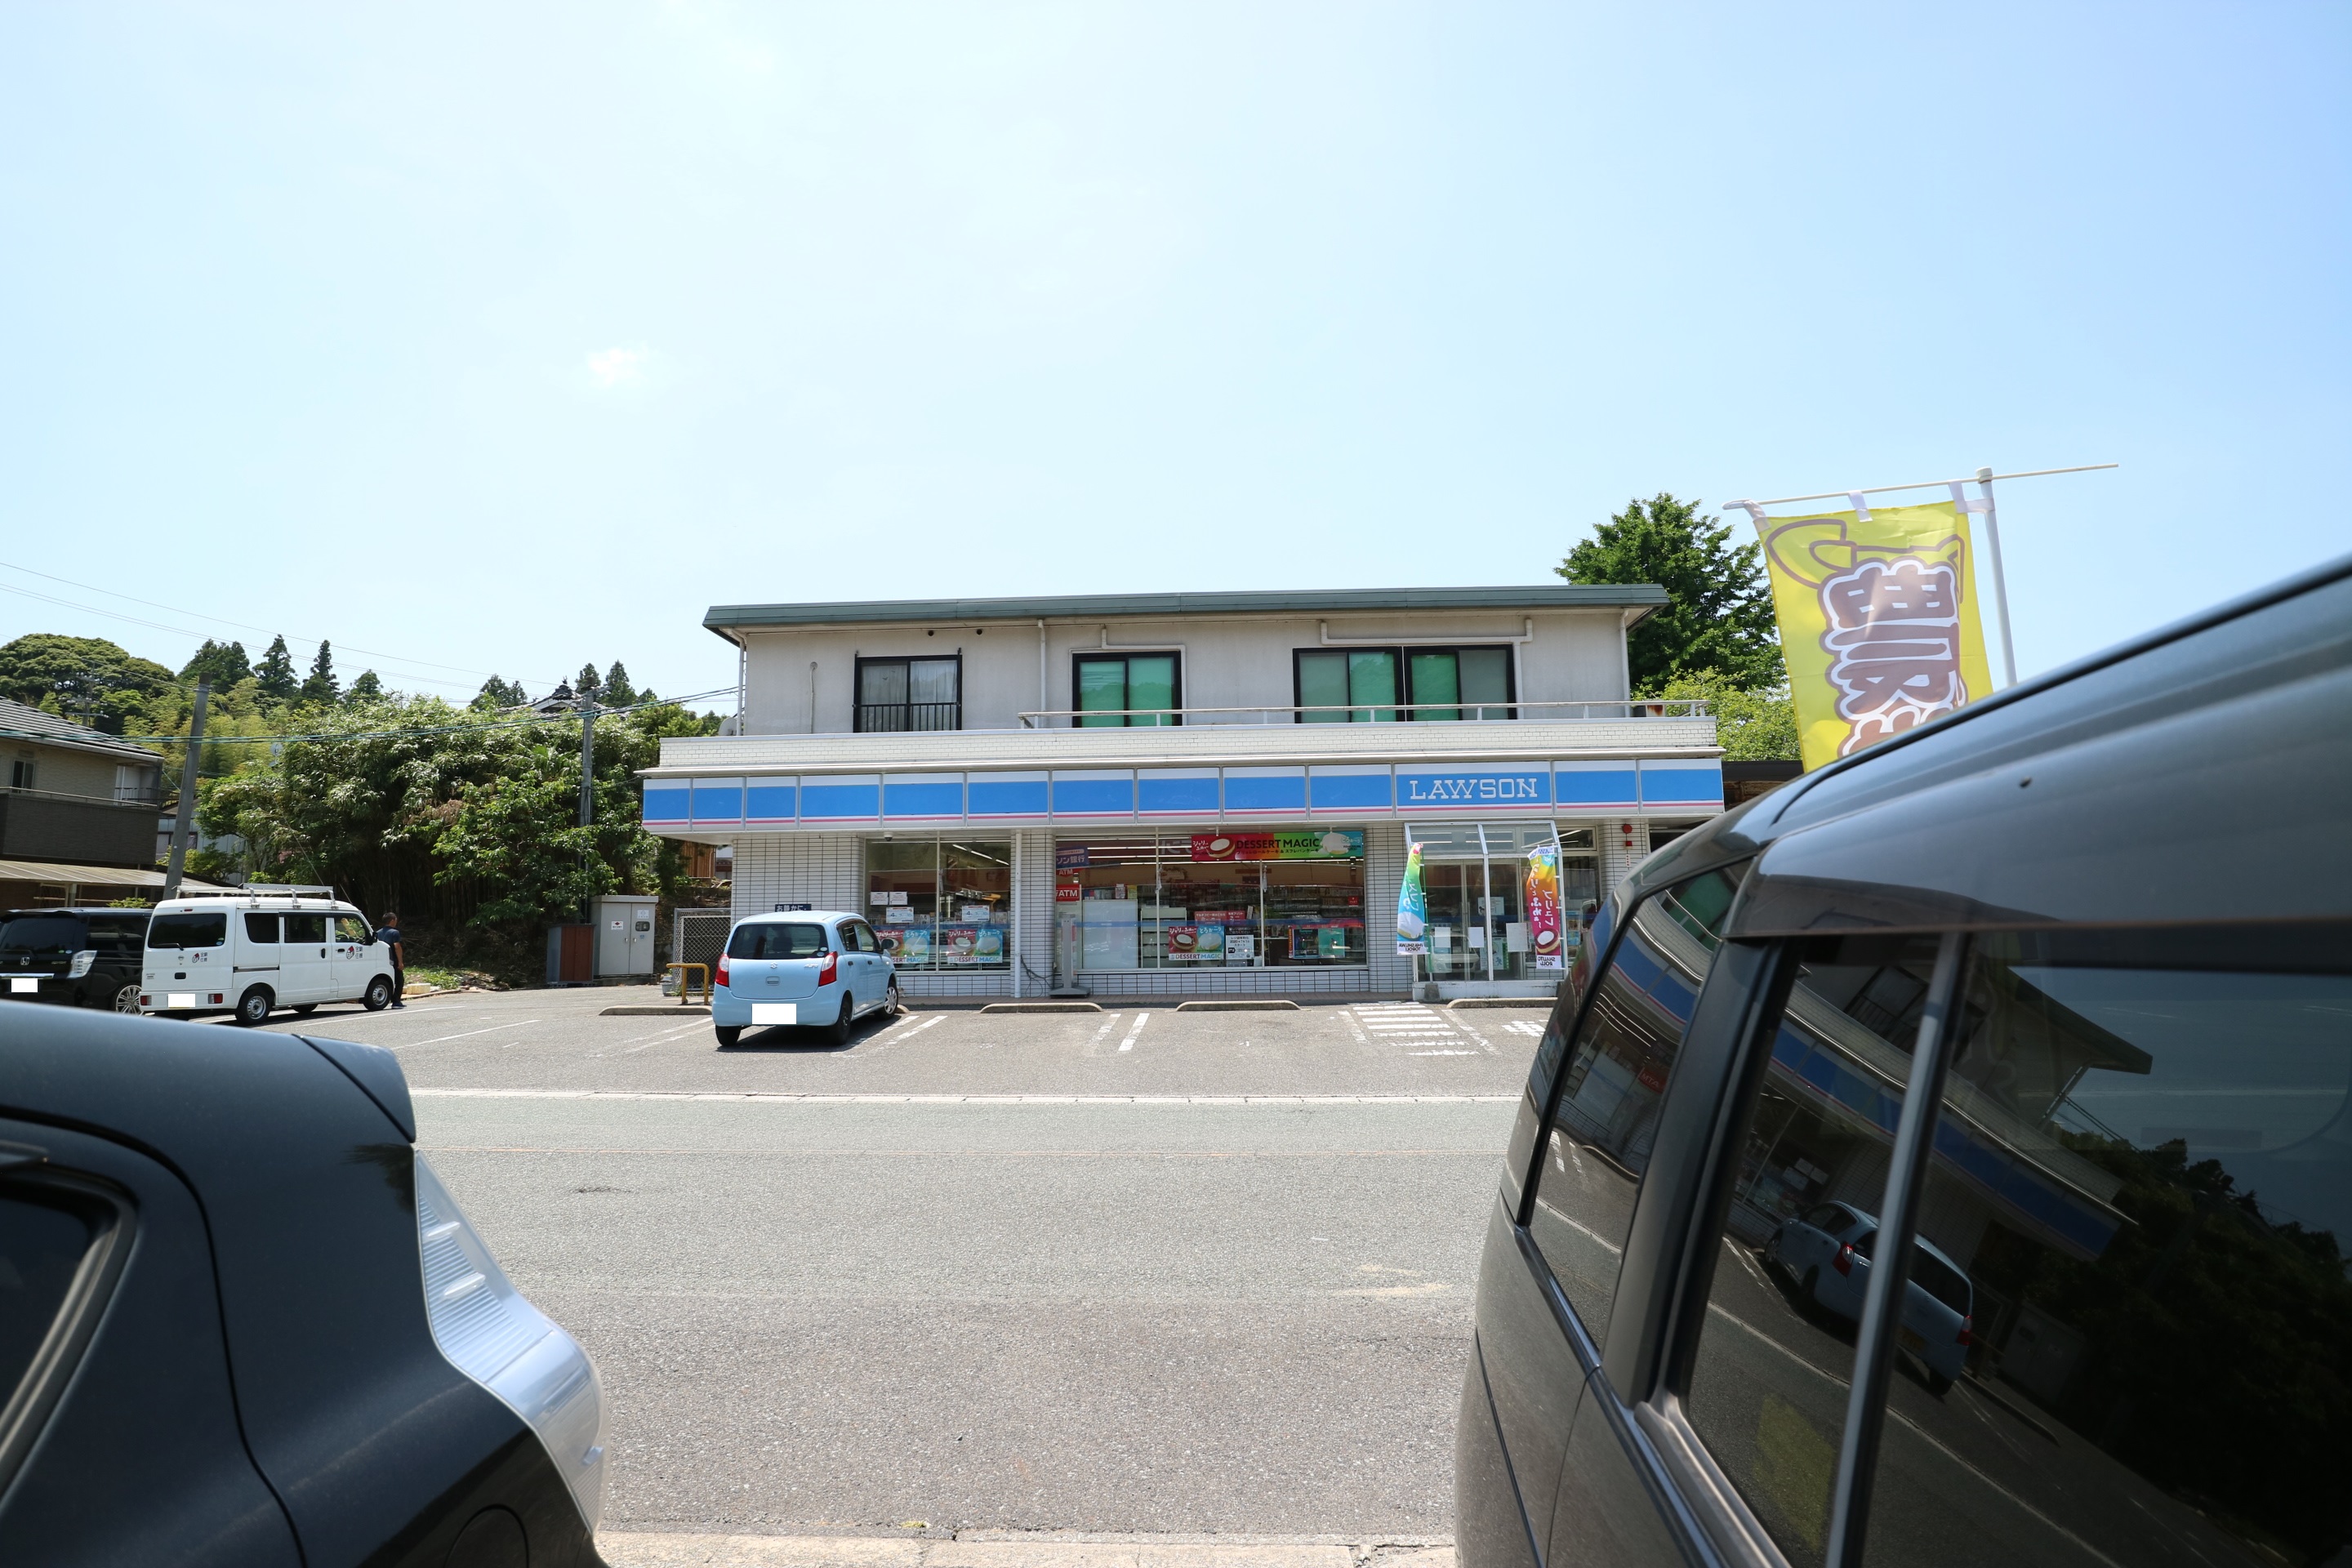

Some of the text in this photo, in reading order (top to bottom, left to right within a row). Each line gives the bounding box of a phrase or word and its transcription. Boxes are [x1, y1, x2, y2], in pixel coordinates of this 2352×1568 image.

[1410, 778, 1539, 800] LAWSON
[1236, 838, 1320, 849] DESSERT MAGIC
[1056, 855, 1085, 864] ソン銀行
